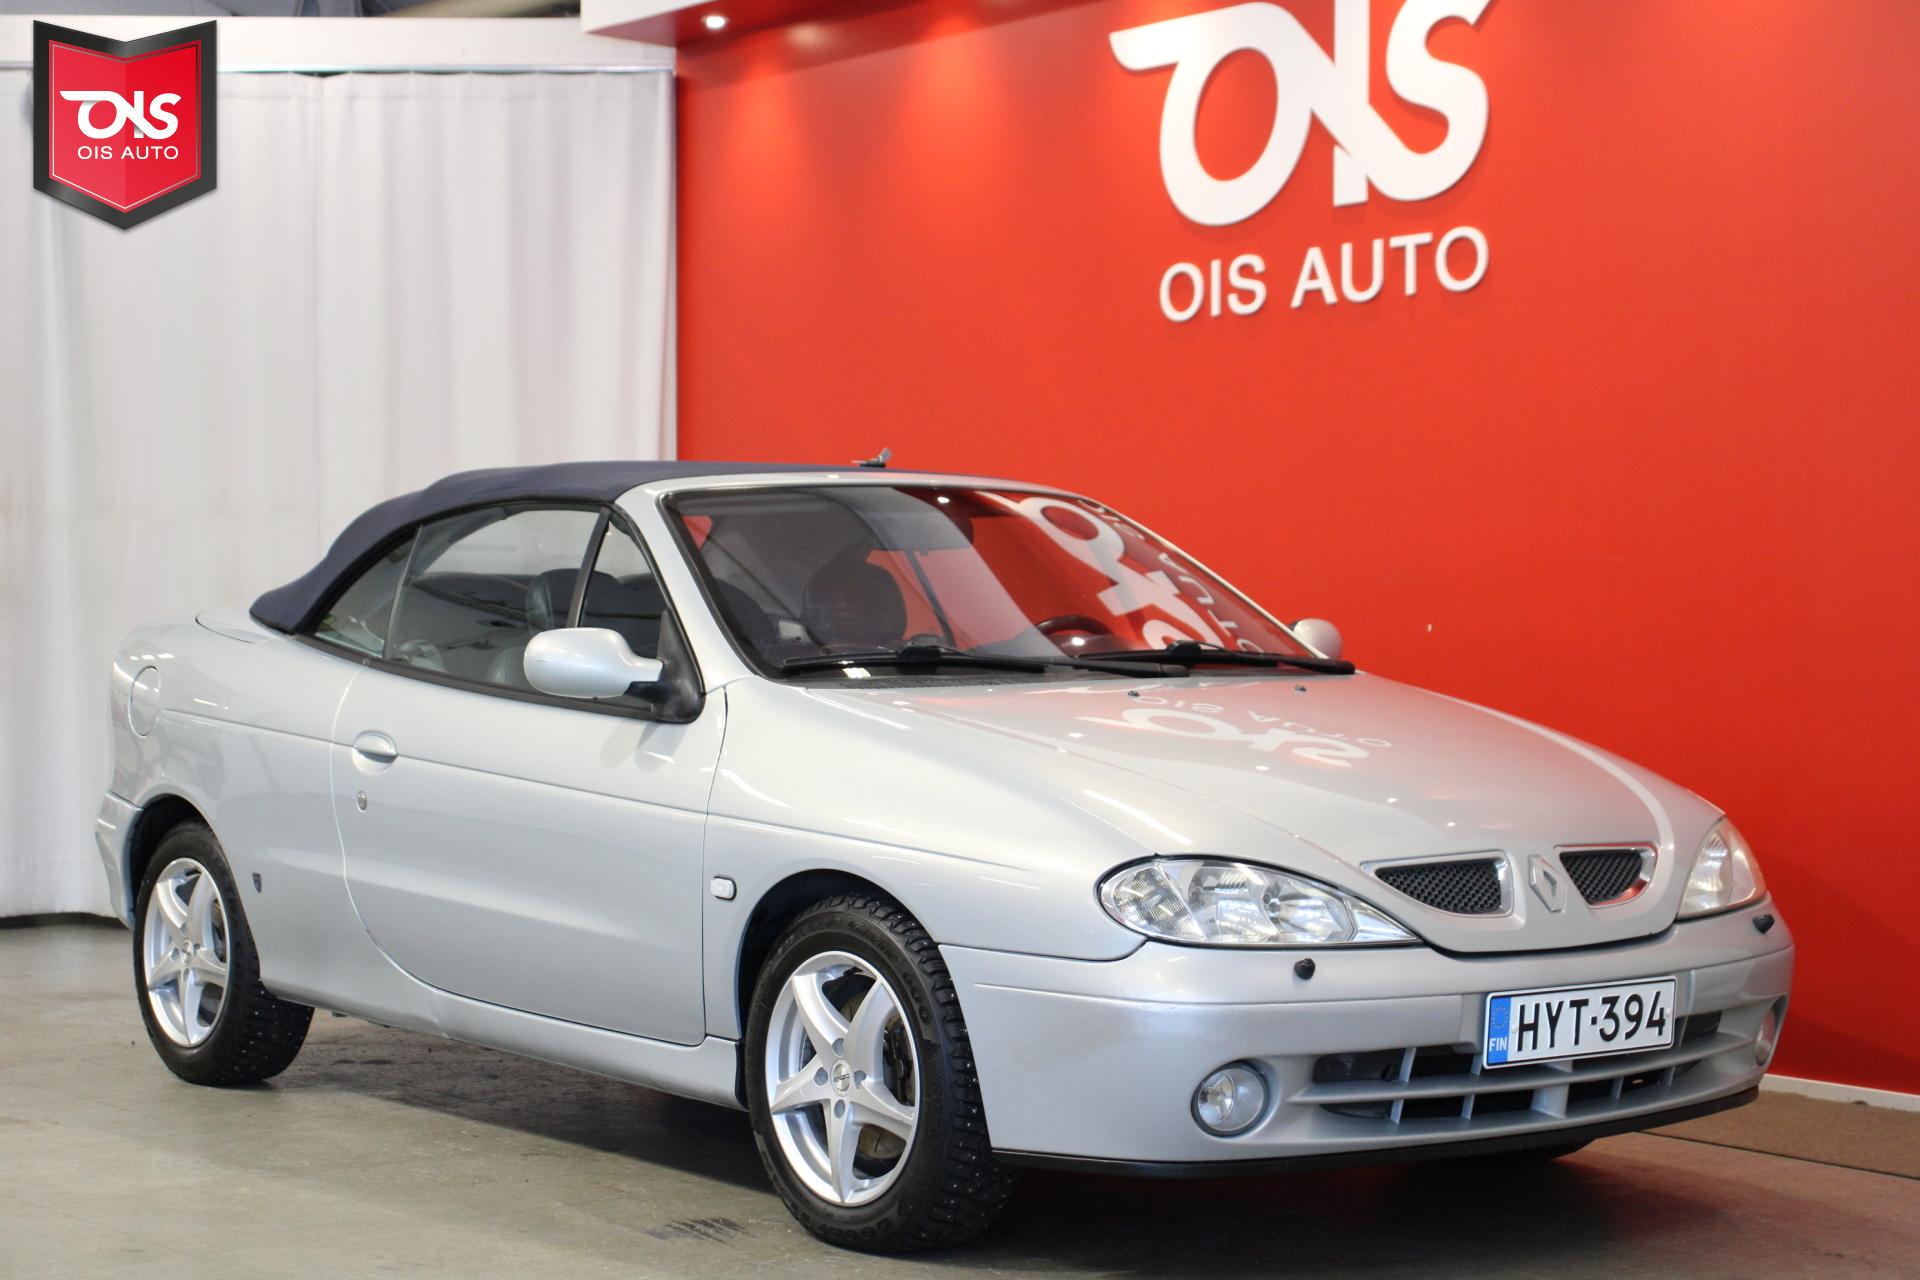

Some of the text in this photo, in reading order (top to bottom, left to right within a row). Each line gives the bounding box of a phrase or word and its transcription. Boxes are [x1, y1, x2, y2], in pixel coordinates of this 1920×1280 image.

[1159, 226, 1489, 323] OIS AUTO
[1488, 1036, 1508, 1052] FIN
